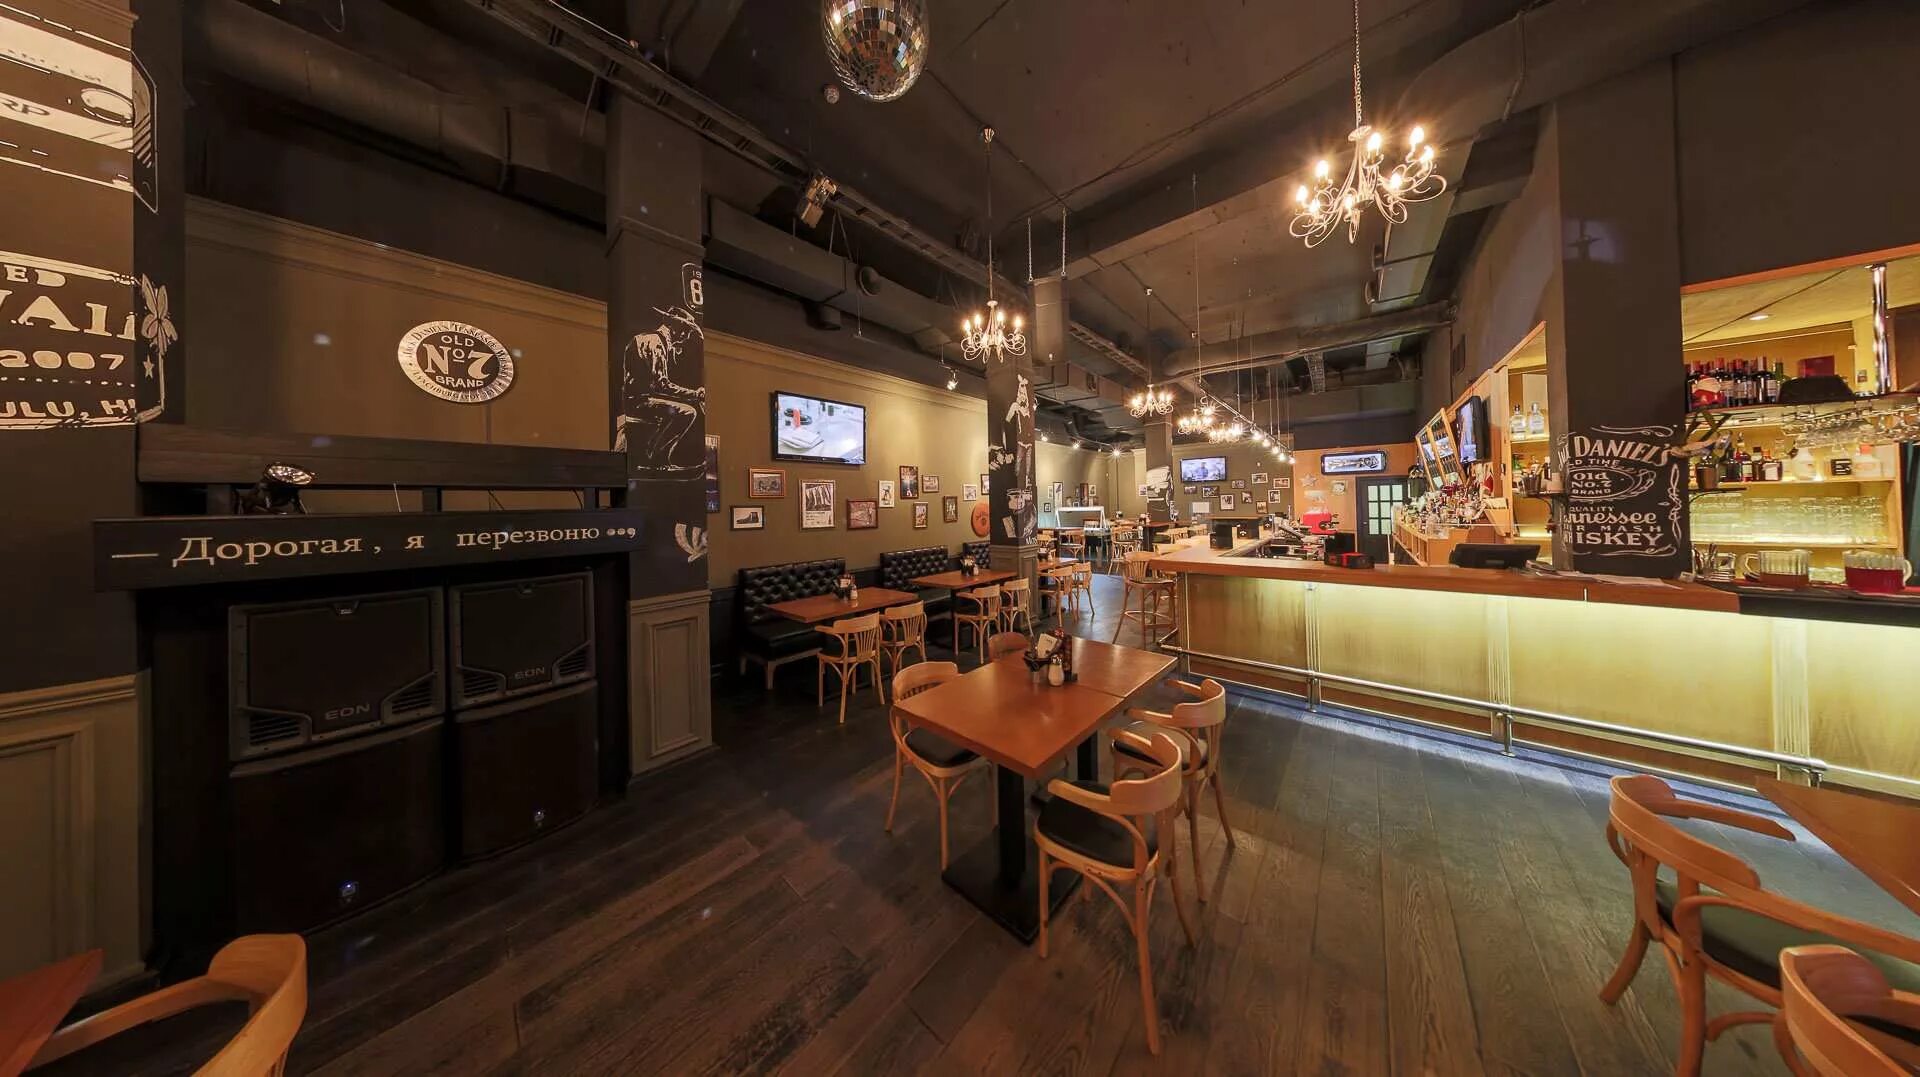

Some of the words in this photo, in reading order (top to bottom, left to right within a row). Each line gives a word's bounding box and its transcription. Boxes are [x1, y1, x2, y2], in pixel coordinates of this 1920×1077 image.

[441, 335, 475, 347] OLD
[435, 375, 484, 388] BRAND
[1600, 525, 1662, 533] MASH
[405, 535, 425, 549] я
[325, 703, 370, 721] EON
